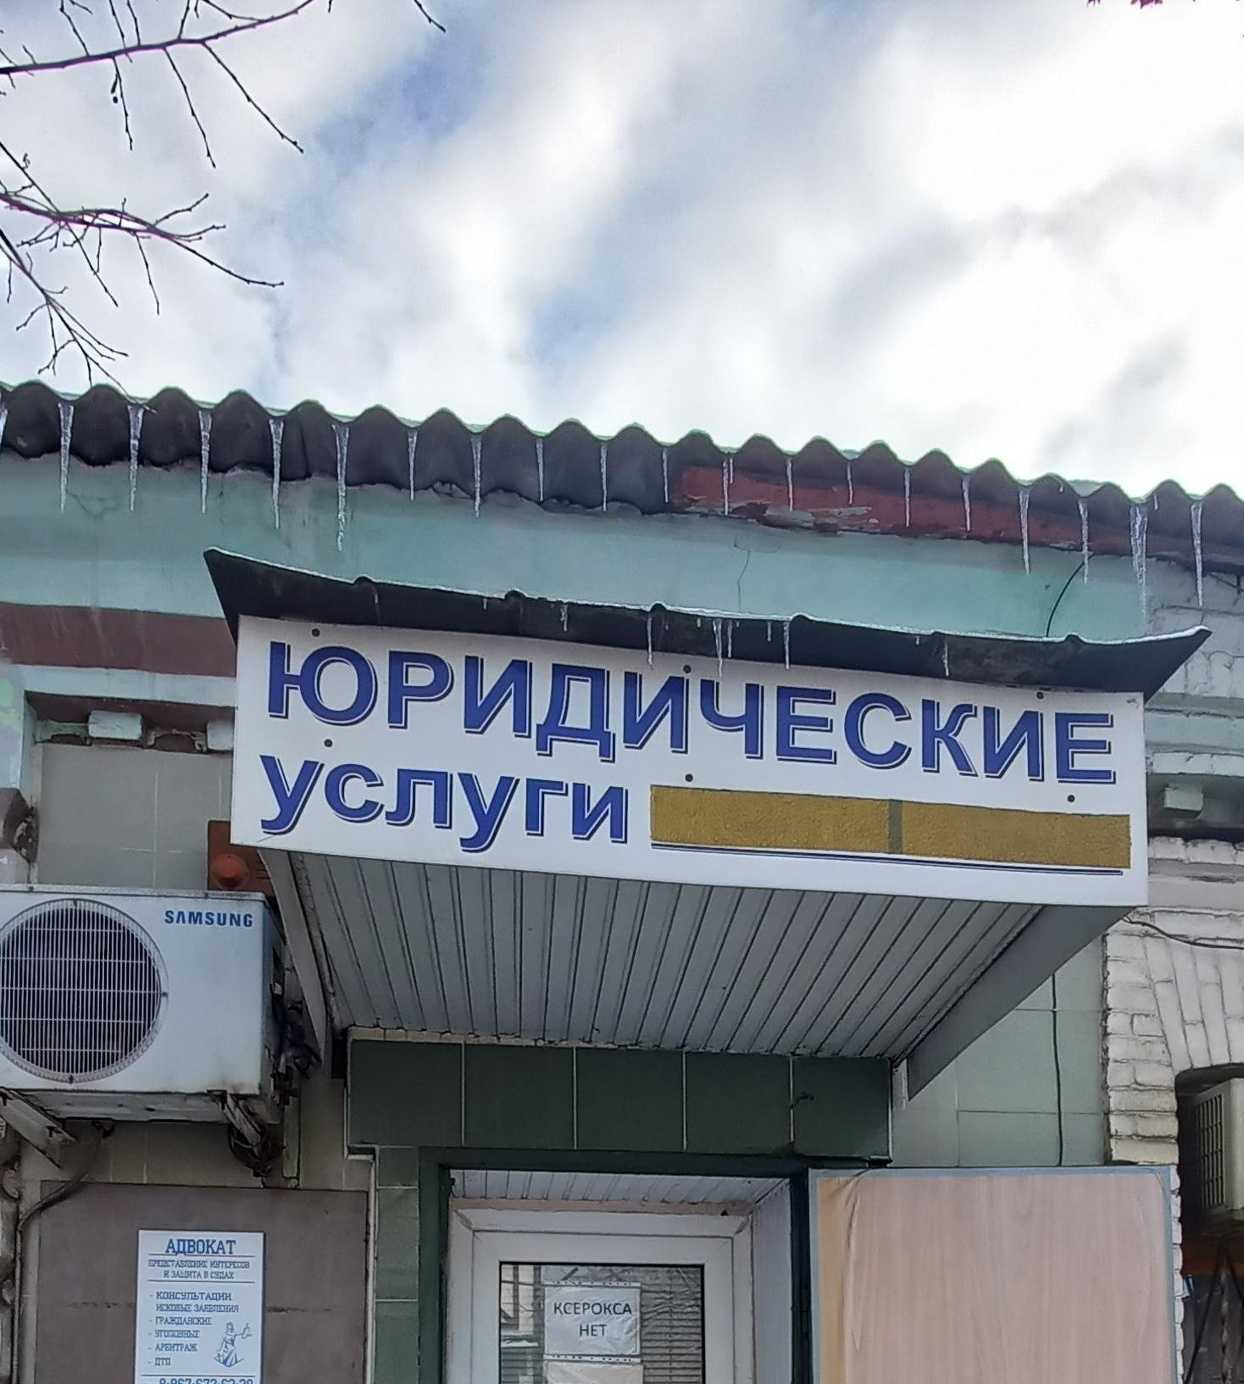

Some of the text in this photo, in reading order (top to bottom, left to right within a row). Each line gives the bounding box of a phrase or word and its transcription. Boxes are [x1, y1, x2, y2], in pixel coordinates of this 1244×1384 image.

[266, 641, 1117, 784] ЮРИДИЧЕСКИЕ
[164, 910, 253, 928] SAMSUNG
[165, 1239, 236, 1256] АДВОКАТ
[171, 1270, 202, 1279] ЗАЩИТА
[156, 1291, 232, 1301] КОНСУЛЬТАЦИИ
[553, 1302, 632, 1316] КСЕРОКСА
[155, 1316, 213, 1326] ГРАЖДАНСКИЕ
[578, 1324, 607, 1337] НЕТ
[155, 1342, 198, 1352] АРБИТРАЖ
